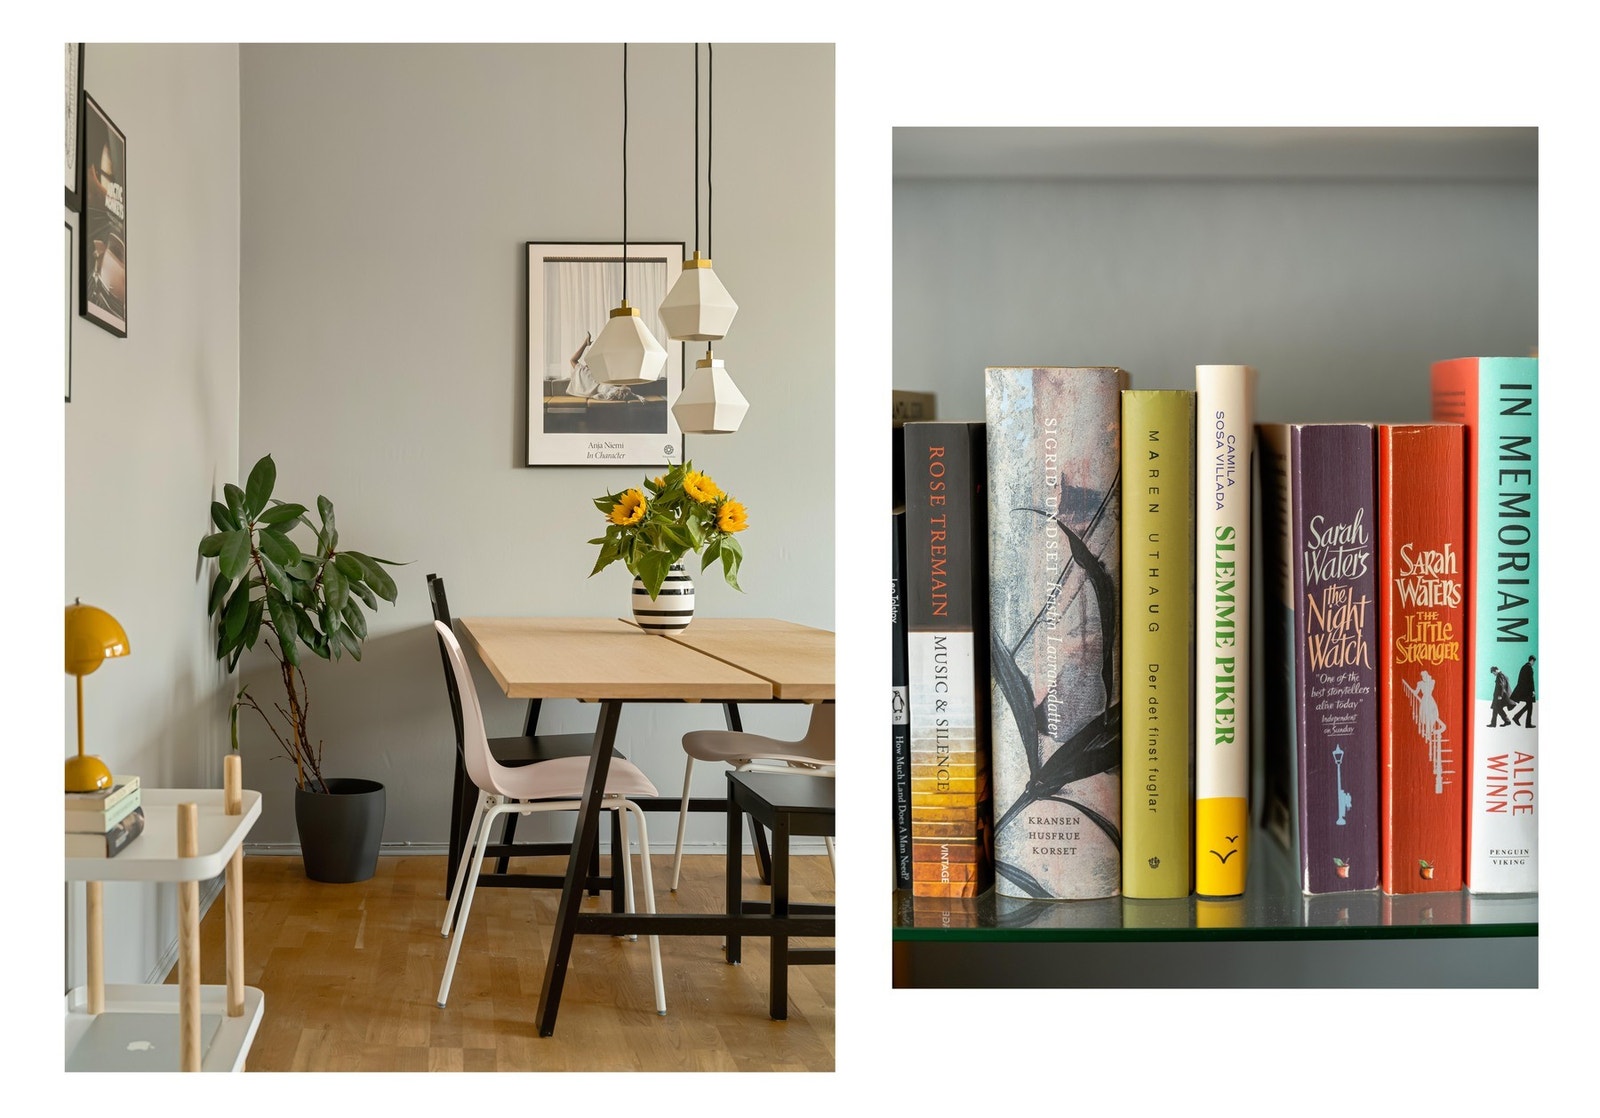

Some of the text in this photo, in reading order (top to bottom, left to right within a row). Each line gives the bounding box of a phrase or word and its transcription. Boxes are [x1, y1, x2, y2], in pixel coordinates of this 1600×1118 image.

[588, 441, 624, 451] Anja Niemi
[594, 451, 626, 459] Character
[1215, 411, 1225, 511] SOSA VILLADA
[1226, 434, 1236, 487] CAMILA
[1497, 384, 1532, 643] IN MEMORIAM
[1307, 507, 1369, 549] Sarah
[1304, 545, 1370, 586] Waters
[1045, 418, 1063, 738] SIGRID UNDSET Kristin Lavransdatter
[1326, 583, 1348, 606] the
[1146, 430, 1160, 813] MAREN UTHAUG Der det finst fuglar
[1307, 586, 1372, 644] Night
[1416, 611, 1439, 620] THE
[1215, 526, 1236, 745] SLEMME PIKER
[1308, 629, 1372, 672] Watch
[929, 446, 950, 884] ROSE TREMAIN MUSIC & SILENCE VINTAGE
[1337, 672, 1347, 685] of
[1348, 671, 1360, 682] the
[1311, 682, 1370, 698] best storytellers
[1315, 700, 1334, 710] alive
[1322, 713, 1357, 725] Independent
[1331, 725, 1354, 736] Sunday
[896, 736, 904, 754] How
[896, 756, 906, 780] Much
[897, 781, 907, 803] Land
[1486, 754, 1509, 813] WINN
[1512, 751, 1535, 816] ALICE
[898, 805, 907, 825] Does
[1028, 816, 1081, 826] KRANSEN
[899, 826, 908, 834] A
[1028, 831, 1081, 841] HUSFRUE
[900, 835, 908, 854] Man
[1032, 846, 1078, 856] KORSET
